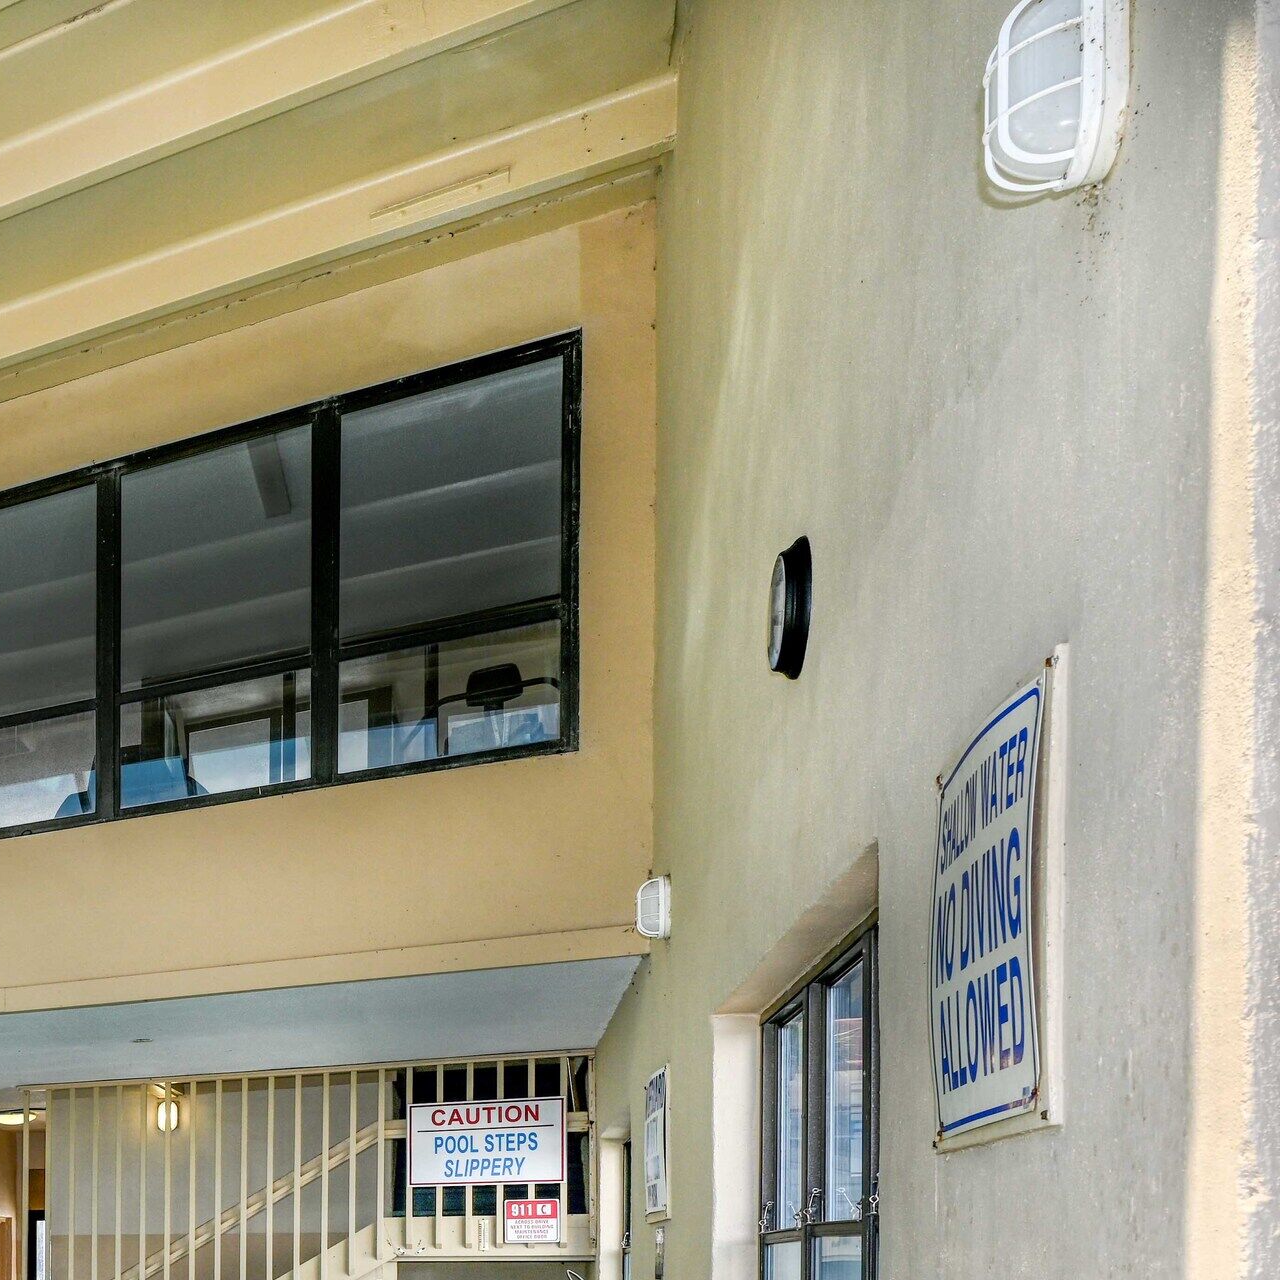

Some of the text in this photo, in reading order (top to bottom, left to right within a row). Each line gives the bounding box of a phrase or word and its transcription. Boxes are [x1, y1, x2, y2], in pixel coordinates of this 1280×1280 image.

[941, 726, 1028, 875] SHALLOW WATER
[936, 826, 1022, 988] NO DIVING
[942, 956, 1024, 1094] ALLOWED
[431, 1104, 540, 1126] CAUTION
[434, 1132, 538, 1154] POOL STEPS
[444, 1157, 525, 1178] SLIPPERY
[512, 1204, 532, 1216] 911
